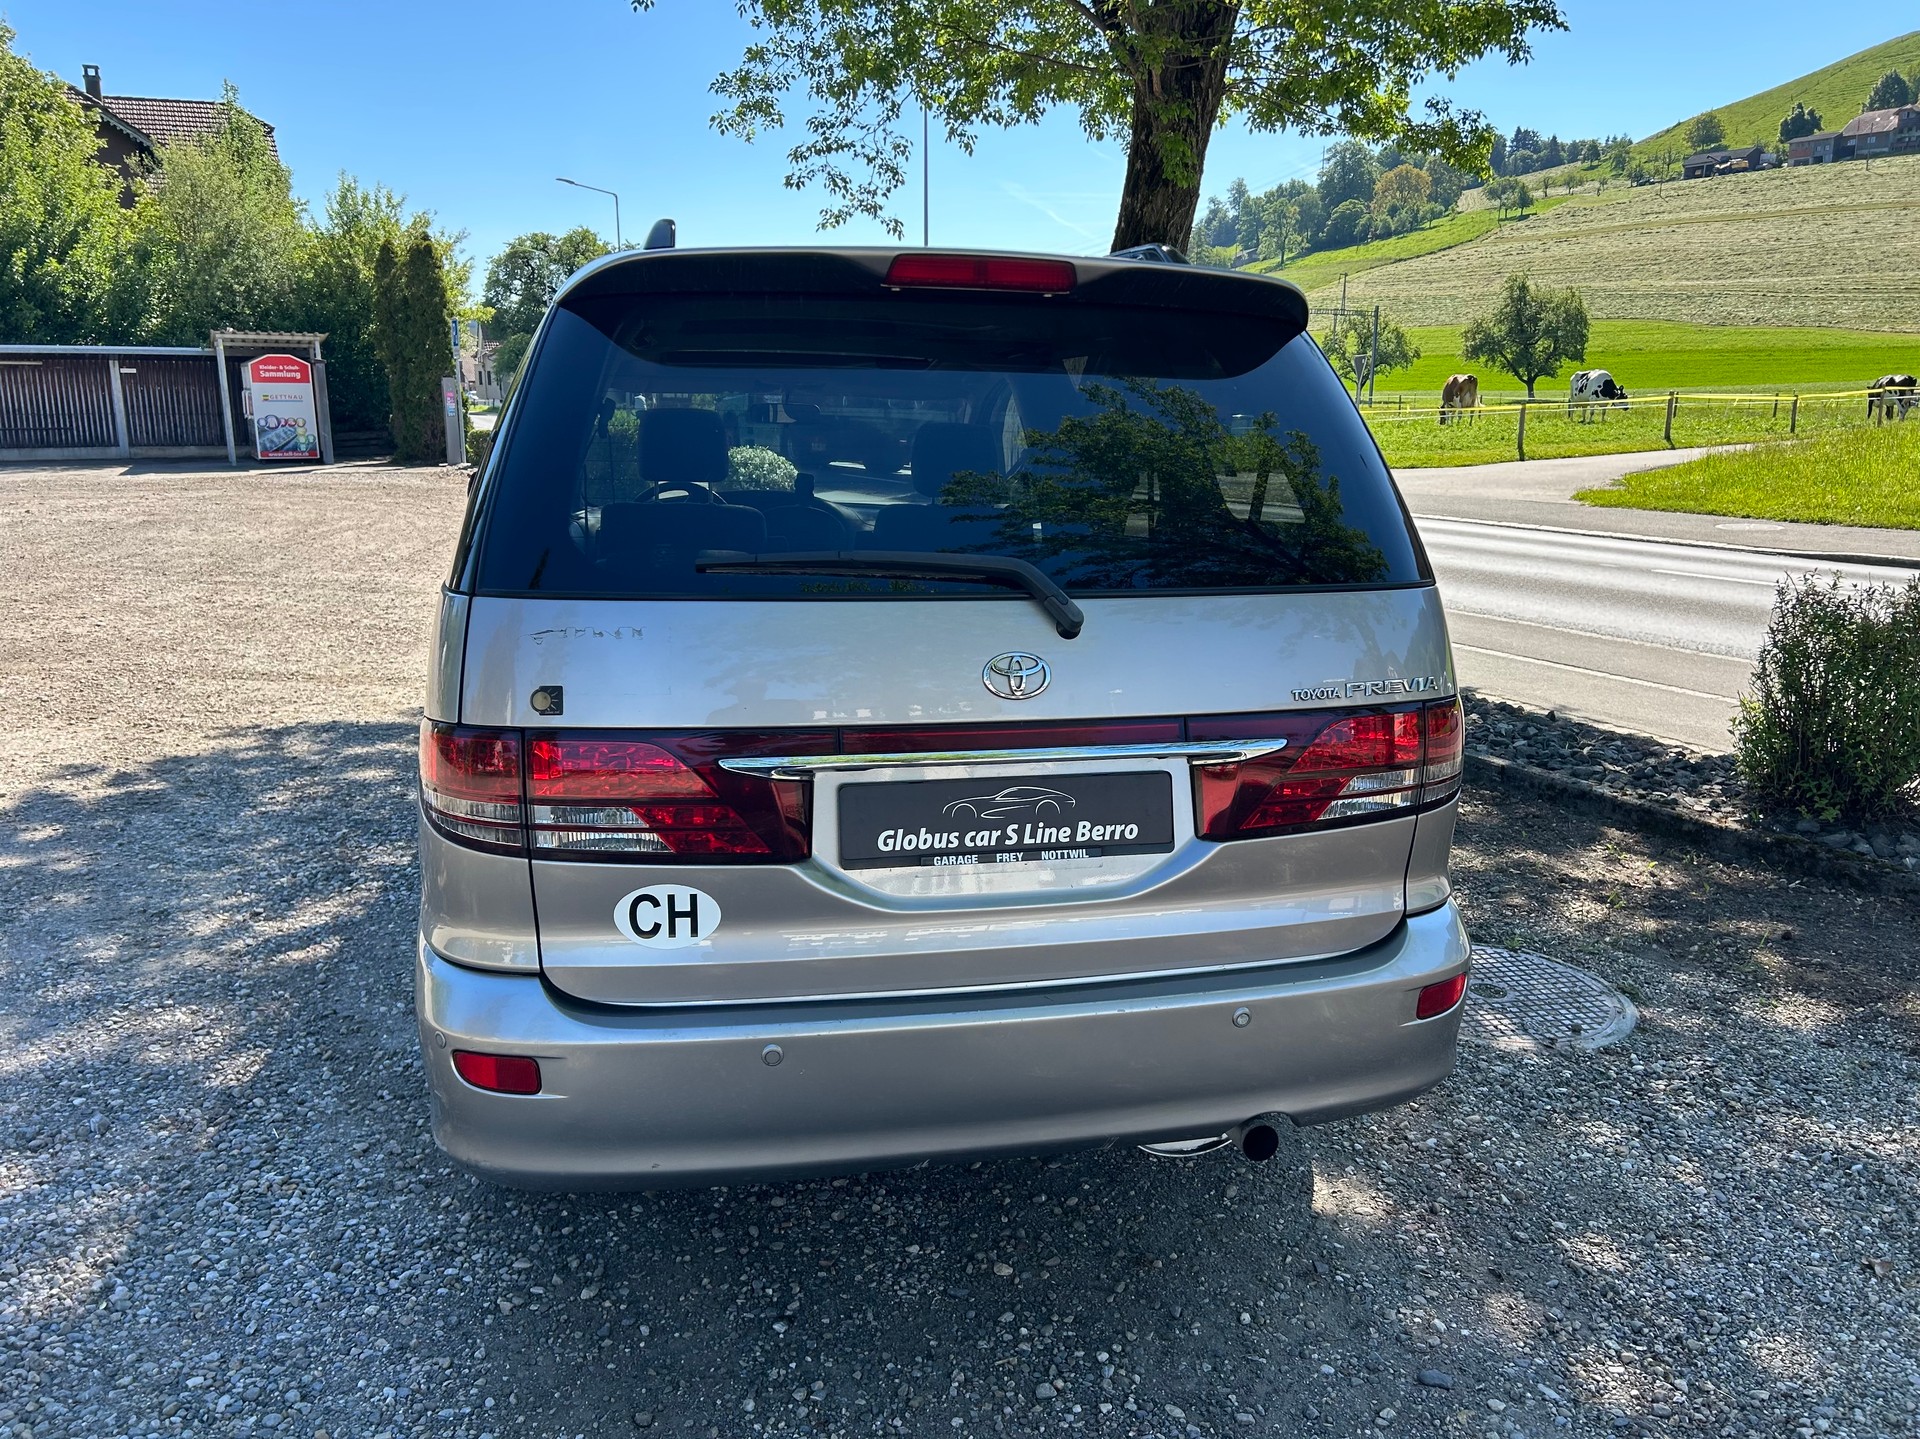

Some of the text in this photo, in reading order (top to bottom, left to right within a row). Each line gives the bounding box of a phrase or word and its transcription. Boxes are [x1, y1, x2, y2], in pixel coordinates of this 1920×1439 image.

[260, 370, 301, 379] Sammlung
[1291, 676, 1438, 701] TOYOTA PREVIA
[877, 820, 1139, 852] Globus car S Line Berro
[933, 848, 1090, 866] GARAGE FREY NOTTWIL
[628, 893, 699, 939] CH
